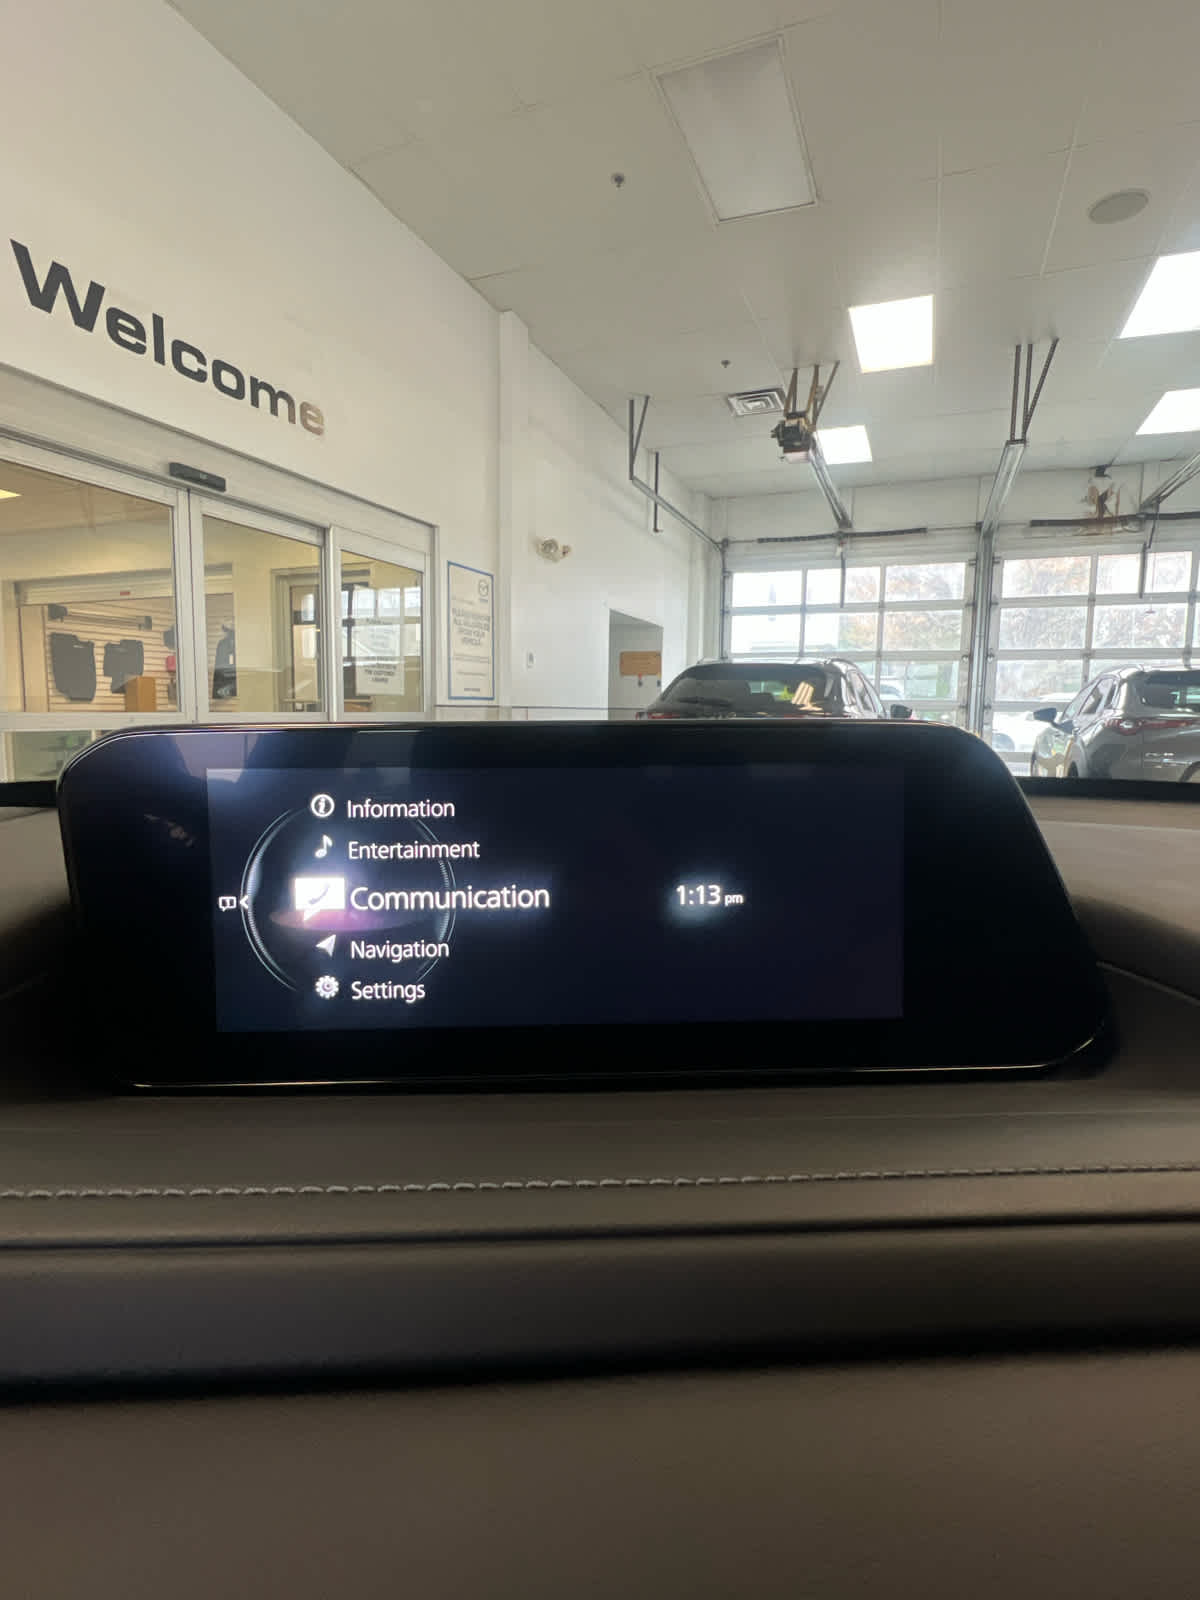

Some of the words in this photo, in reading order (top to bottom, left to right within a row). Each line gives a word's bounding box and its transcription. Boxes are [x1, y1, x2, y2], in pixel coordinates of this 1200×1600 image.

[9, 238, 325, 436] Welcome
[347, 798, 456, 819] Information
[348, 841, 481, 861] Entertainment
[350, 885, 551, 910] Communication
[676, 884, 721, 905] 1:13
[724, 894, 744, 907] pm
[350, 939, 450, 963] Navigation
[350, 980, 426, 1004] Settings
